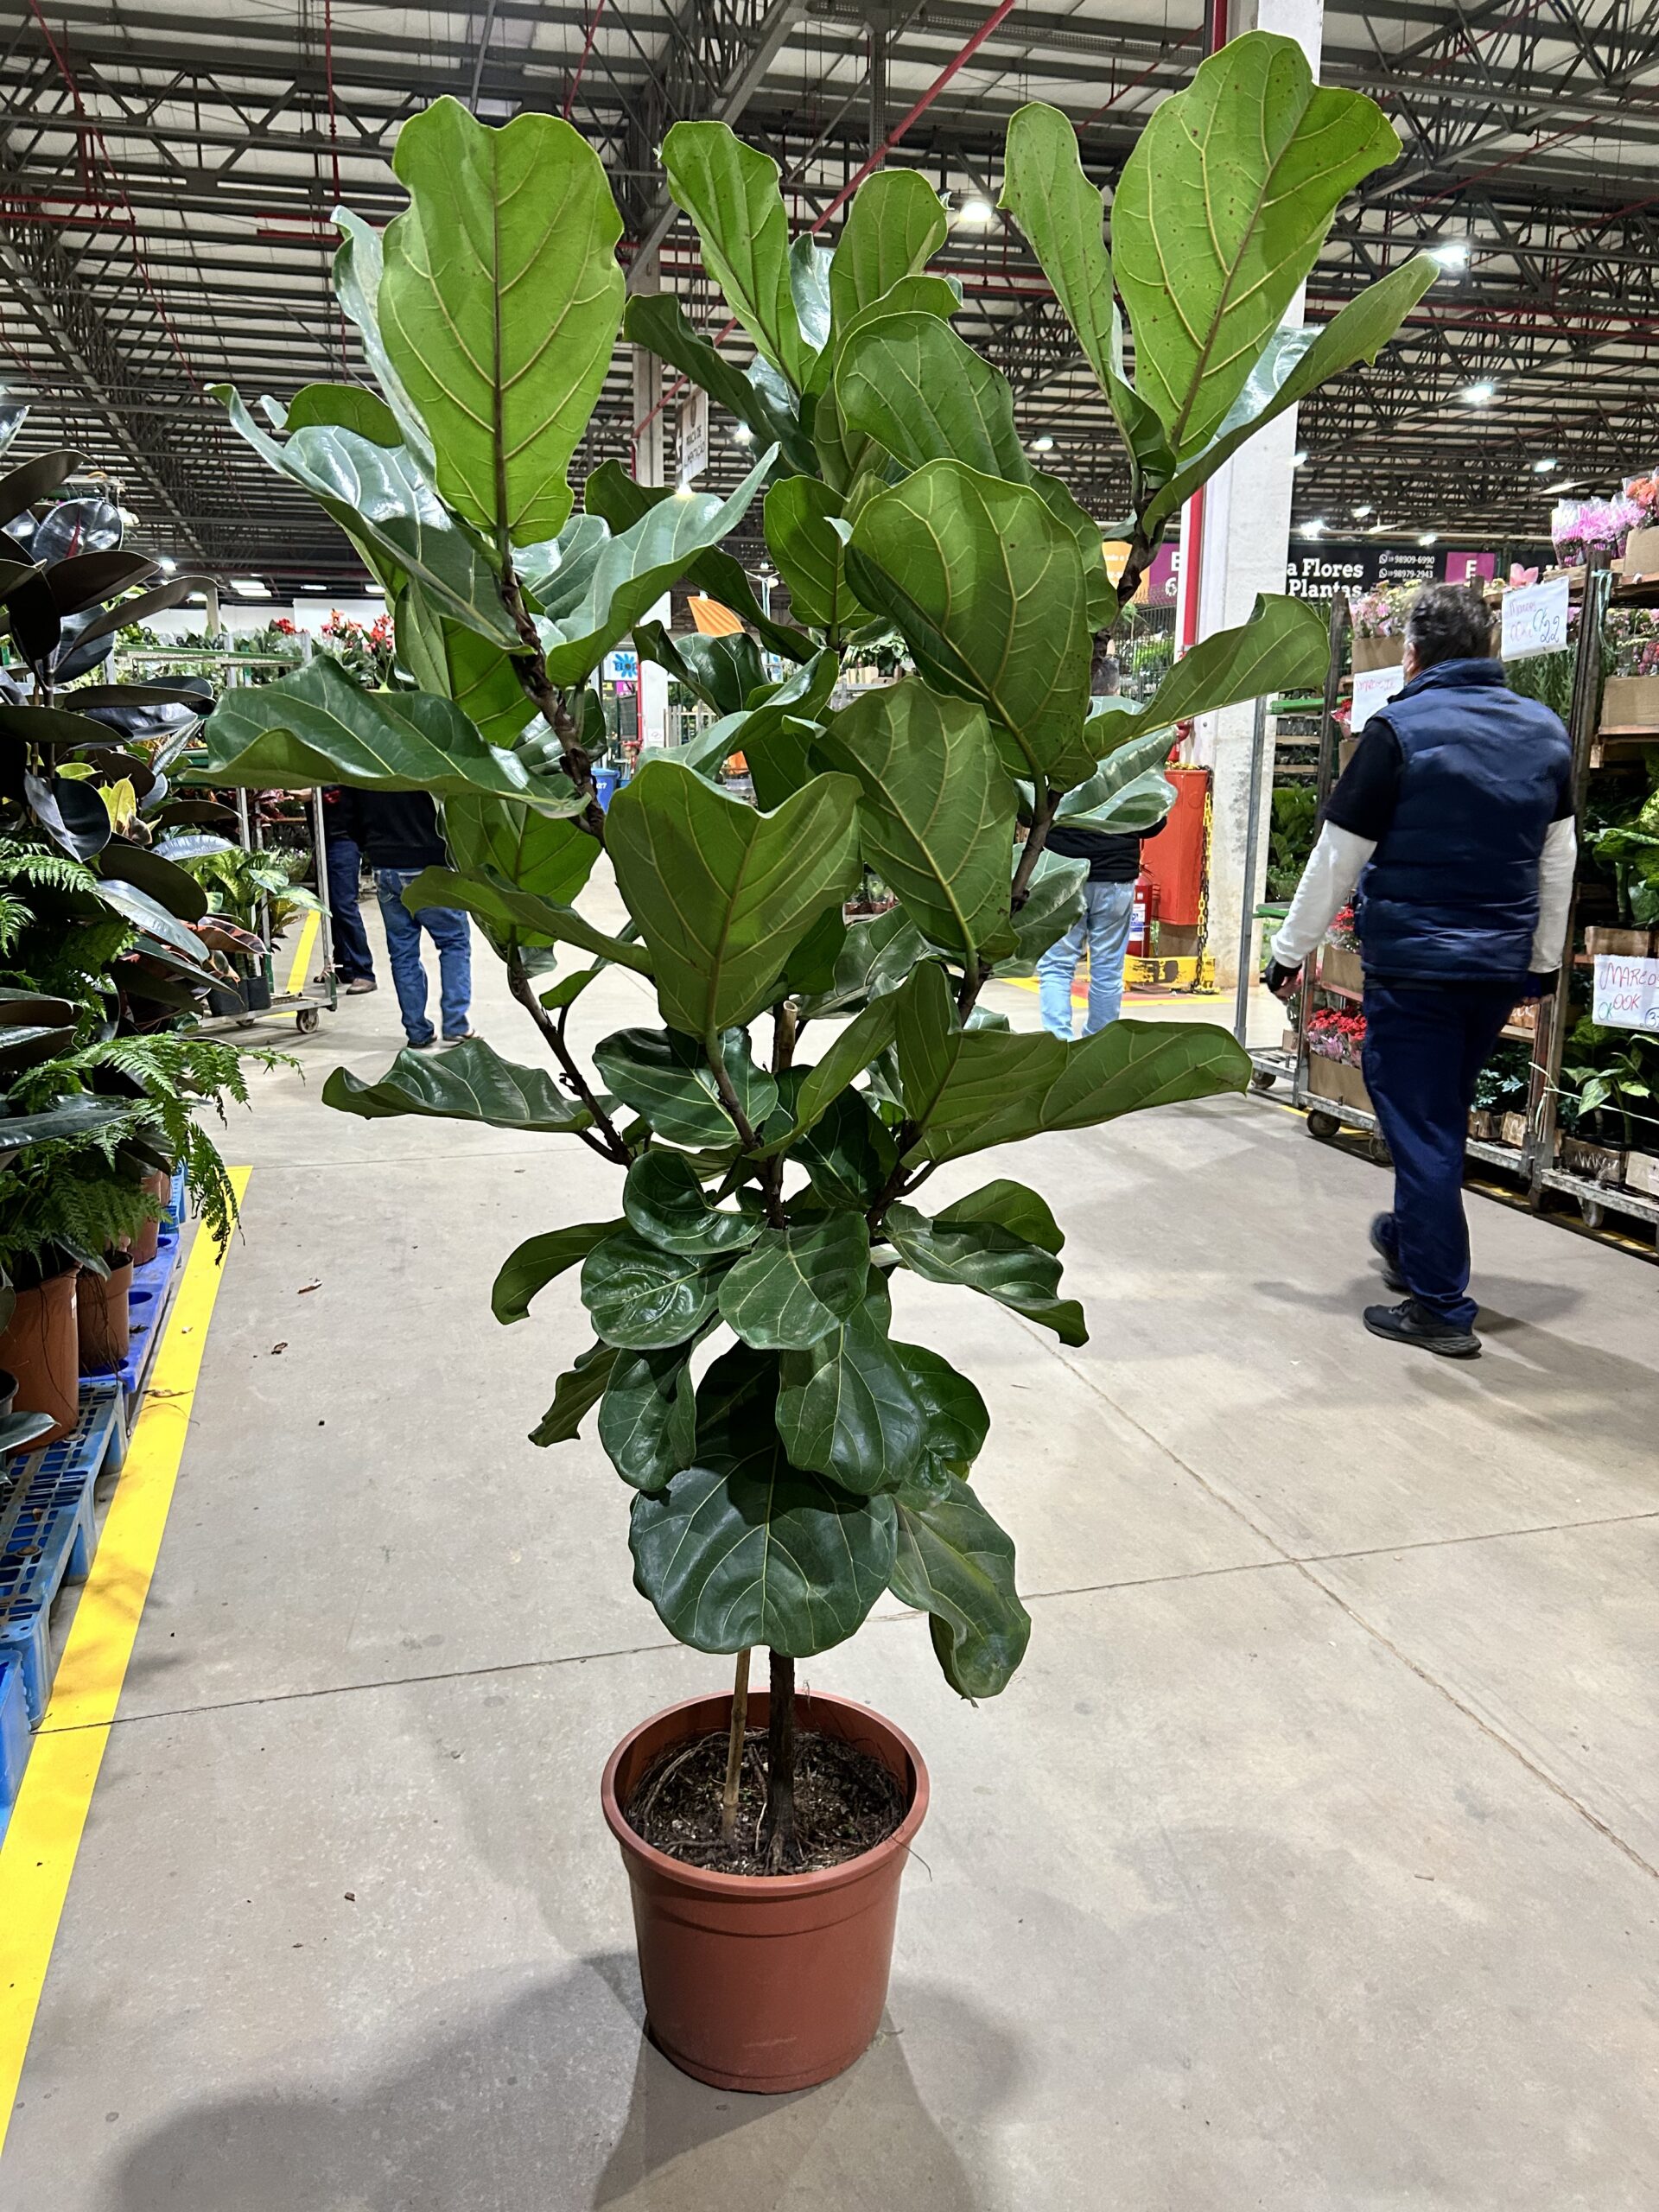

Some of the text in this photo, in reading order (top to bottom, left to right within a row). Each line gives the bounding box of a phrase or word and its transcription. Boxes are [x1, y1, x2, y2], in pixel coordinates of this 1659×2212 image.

[1302, 558, 1364, 578] Flores
[1465, 559, 1478, 579] E
[1541, 615, 1560, 644] 22
